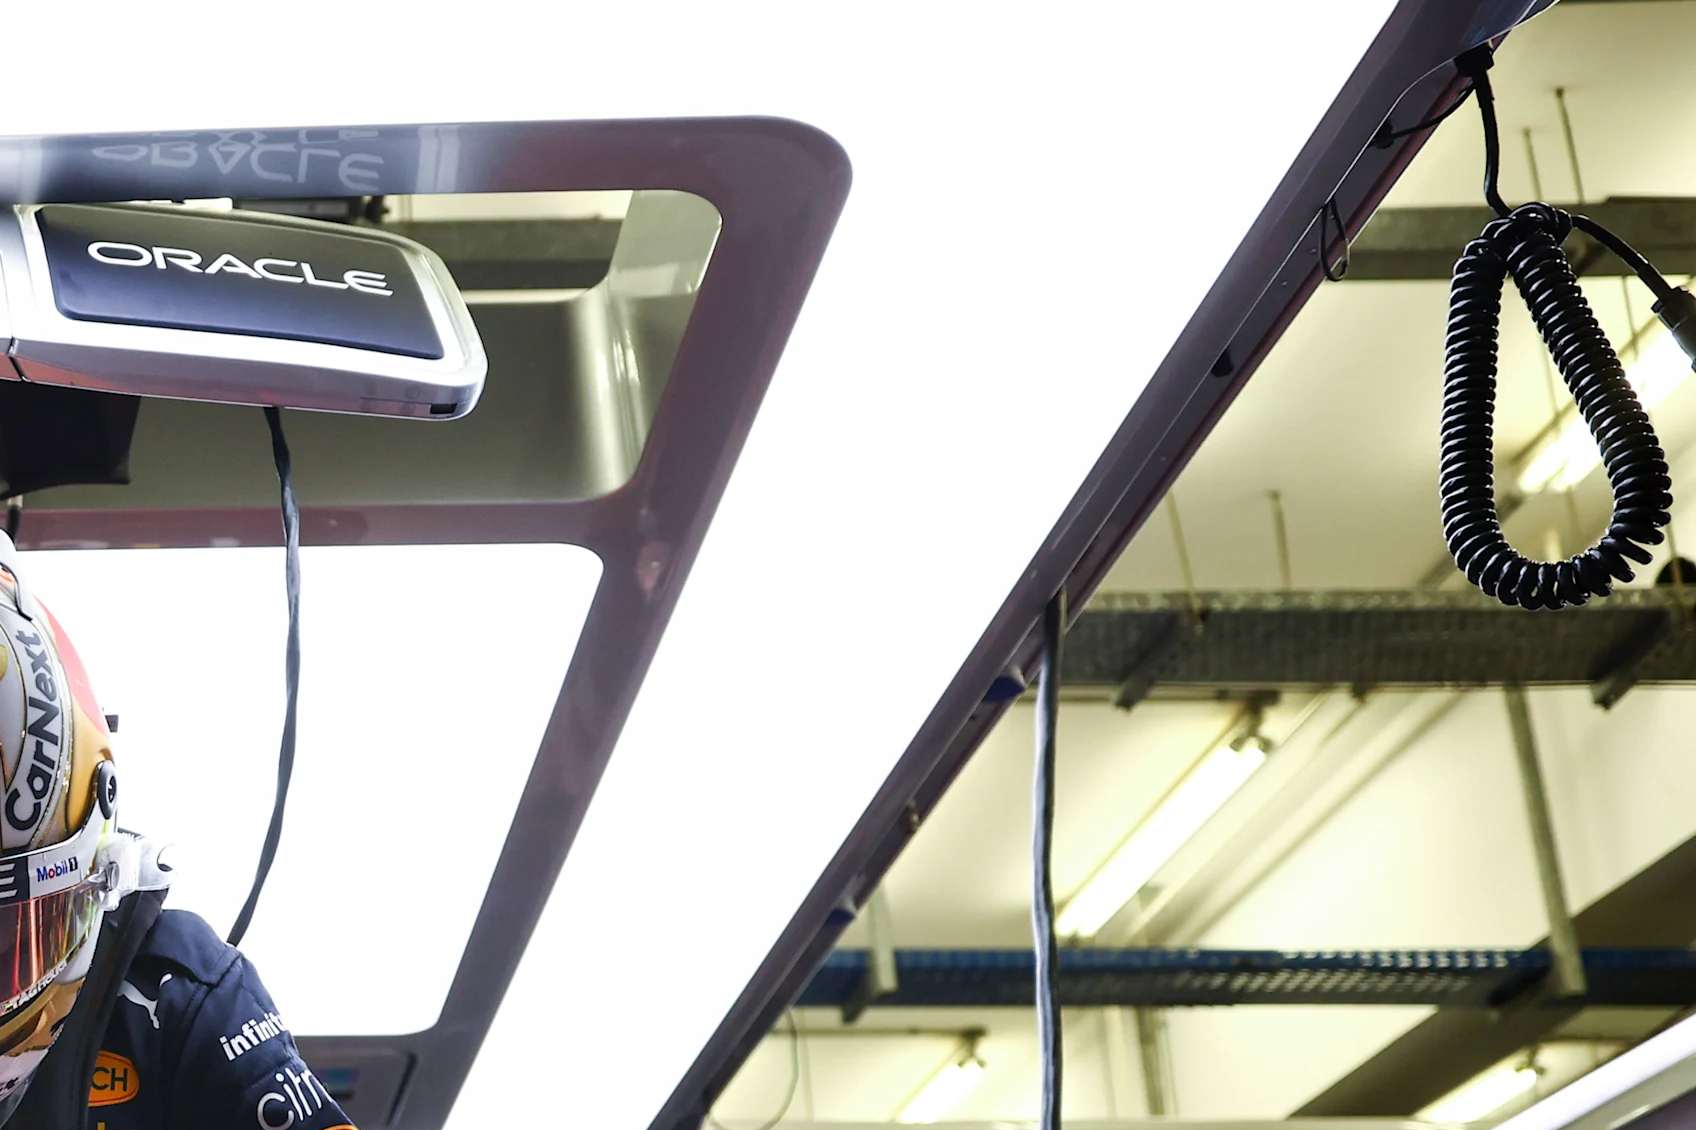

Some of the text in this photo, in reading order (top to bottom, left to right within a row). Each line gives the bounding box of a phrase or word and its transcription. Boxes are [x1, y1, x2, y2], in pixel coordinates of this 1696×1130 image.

[88, 240, 394, 297] ORACLE
[6, 629, 62, 830] CarNext
[36, 860, 69, 883] Mobil
